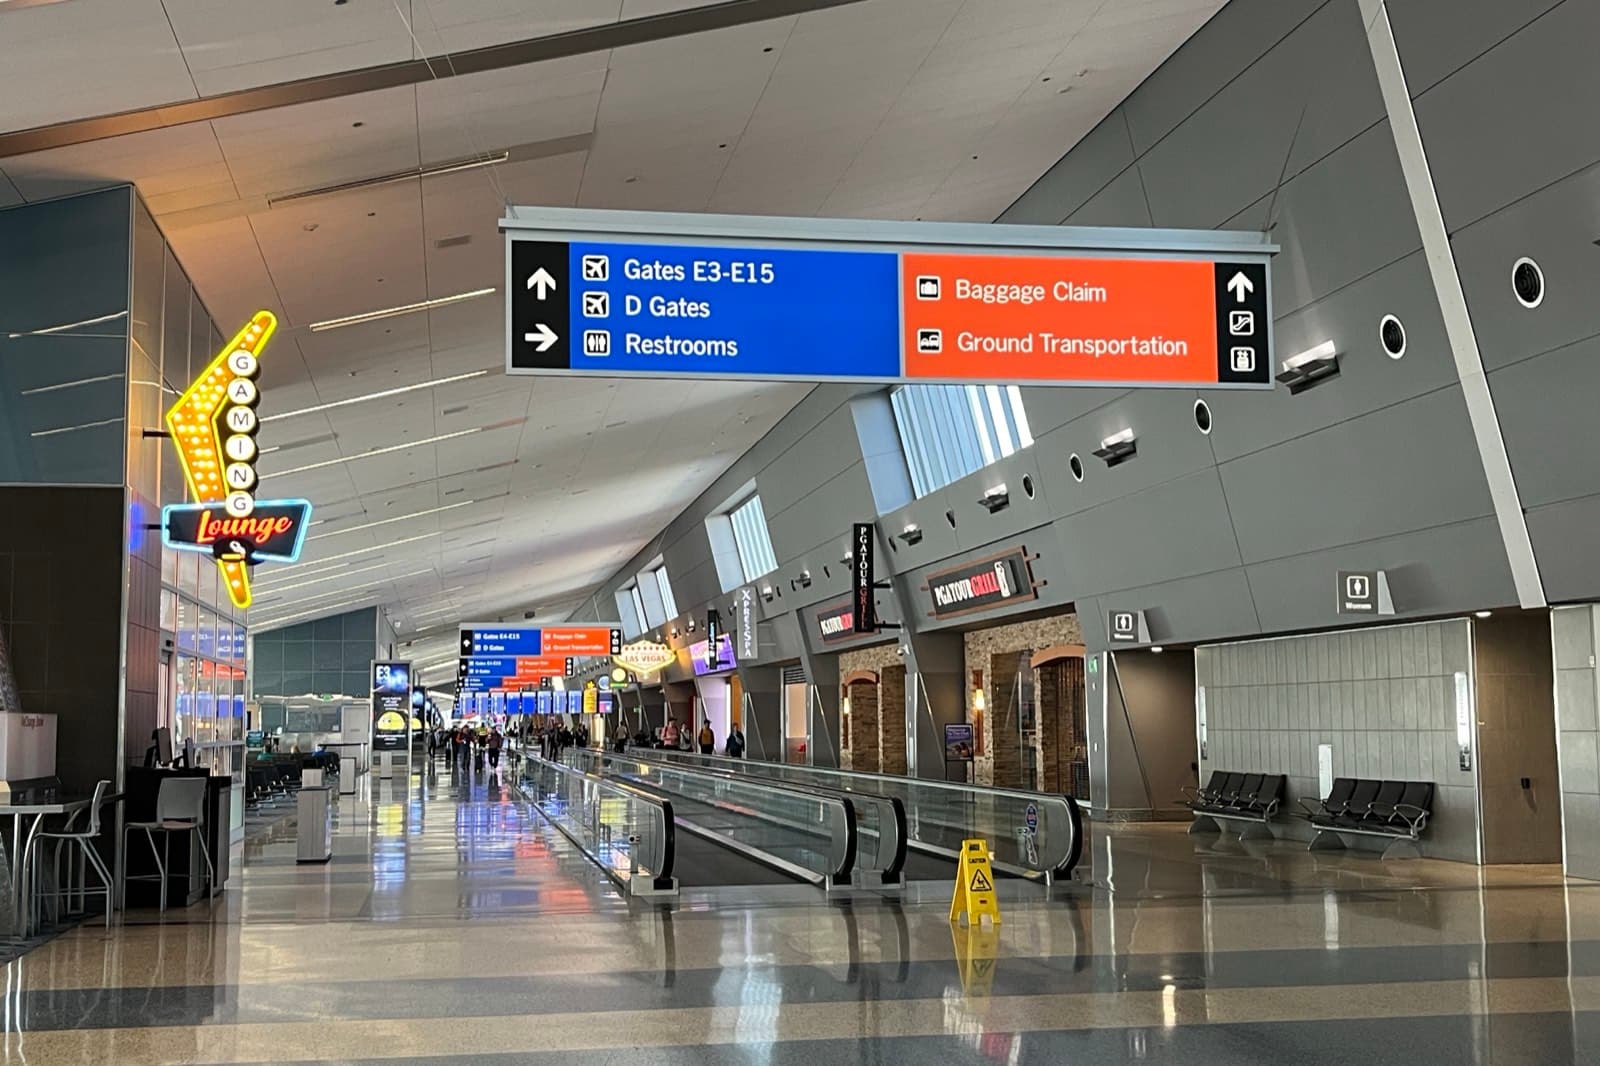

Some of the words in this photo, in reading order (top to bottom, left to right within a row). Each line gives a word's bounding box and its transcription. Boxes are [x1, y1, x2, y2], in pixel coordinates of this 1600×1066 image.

[624, 258, 685, 281] Gates
[693, 261, 775, 284] E3-E15
[955, 279, 1045, 304] Baggage
[1053, 281, 1107, 302] Claim
[625, 295, 641, 316] D
[649, 296, 710, 318] Gates
[625, 333, 738, 356] Restrooms
[957, 332, 1033, 353] Ground
[1039, 333, 1187, 357] Transportation
[197, 510, 293, 543] Lounge
